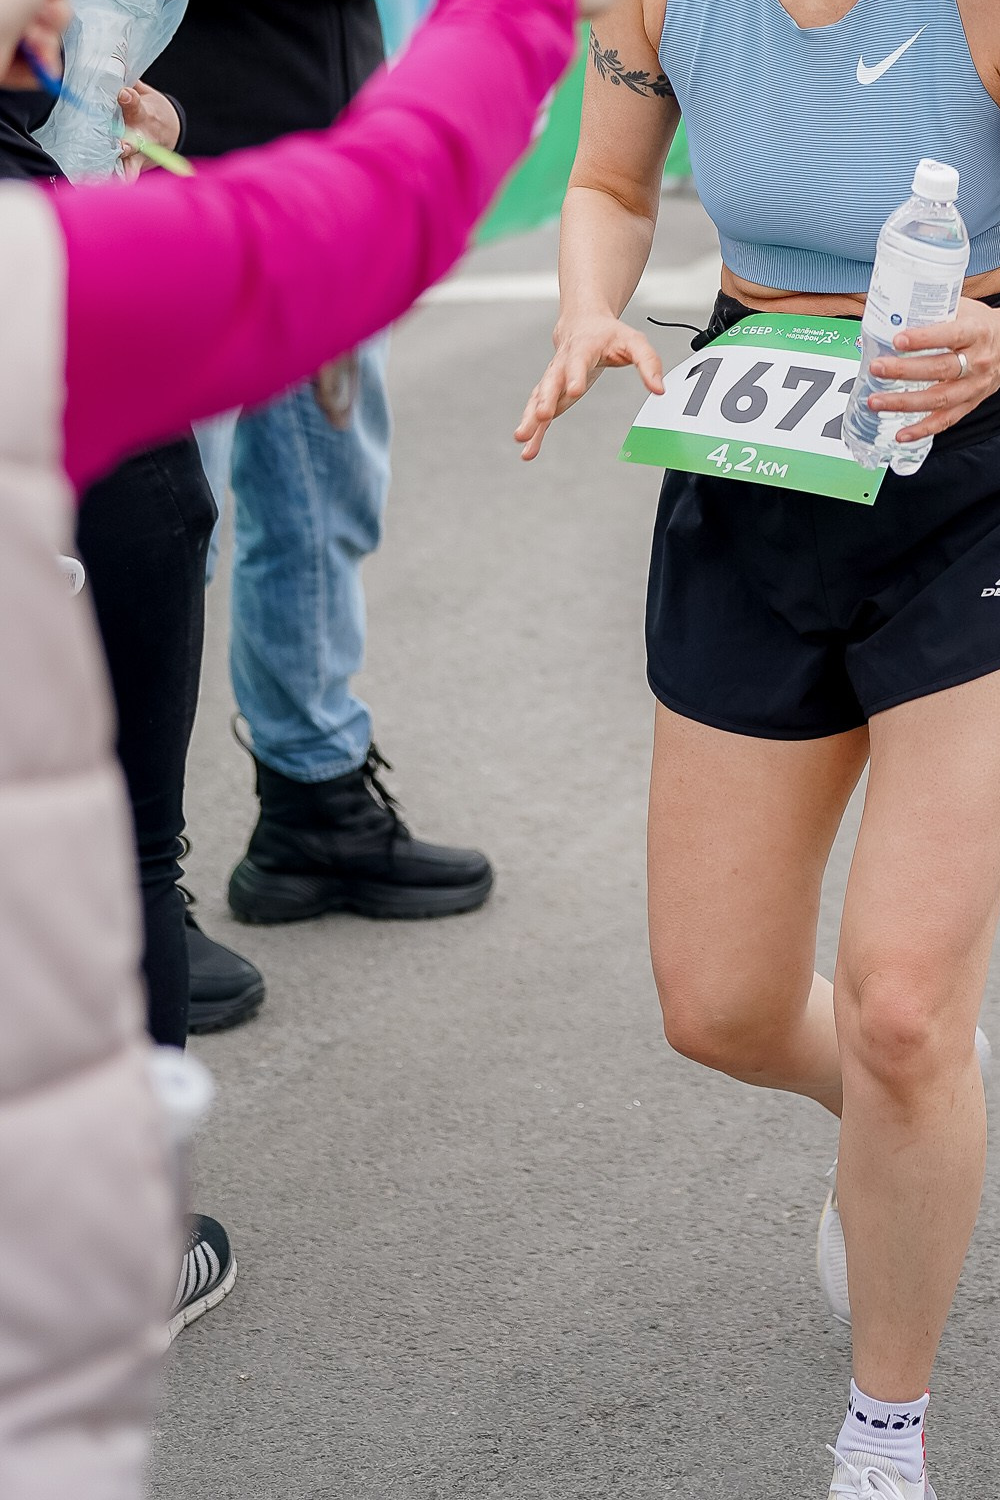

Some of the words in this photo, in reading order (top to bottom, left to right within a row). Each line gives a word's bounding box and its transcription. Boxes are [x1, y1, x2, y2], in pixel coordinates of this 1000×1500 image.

[741, 326, 773, 335] СБЕР
[791, 327, 826, 337] зелёный
[785, 333, 820, 342] марафон
